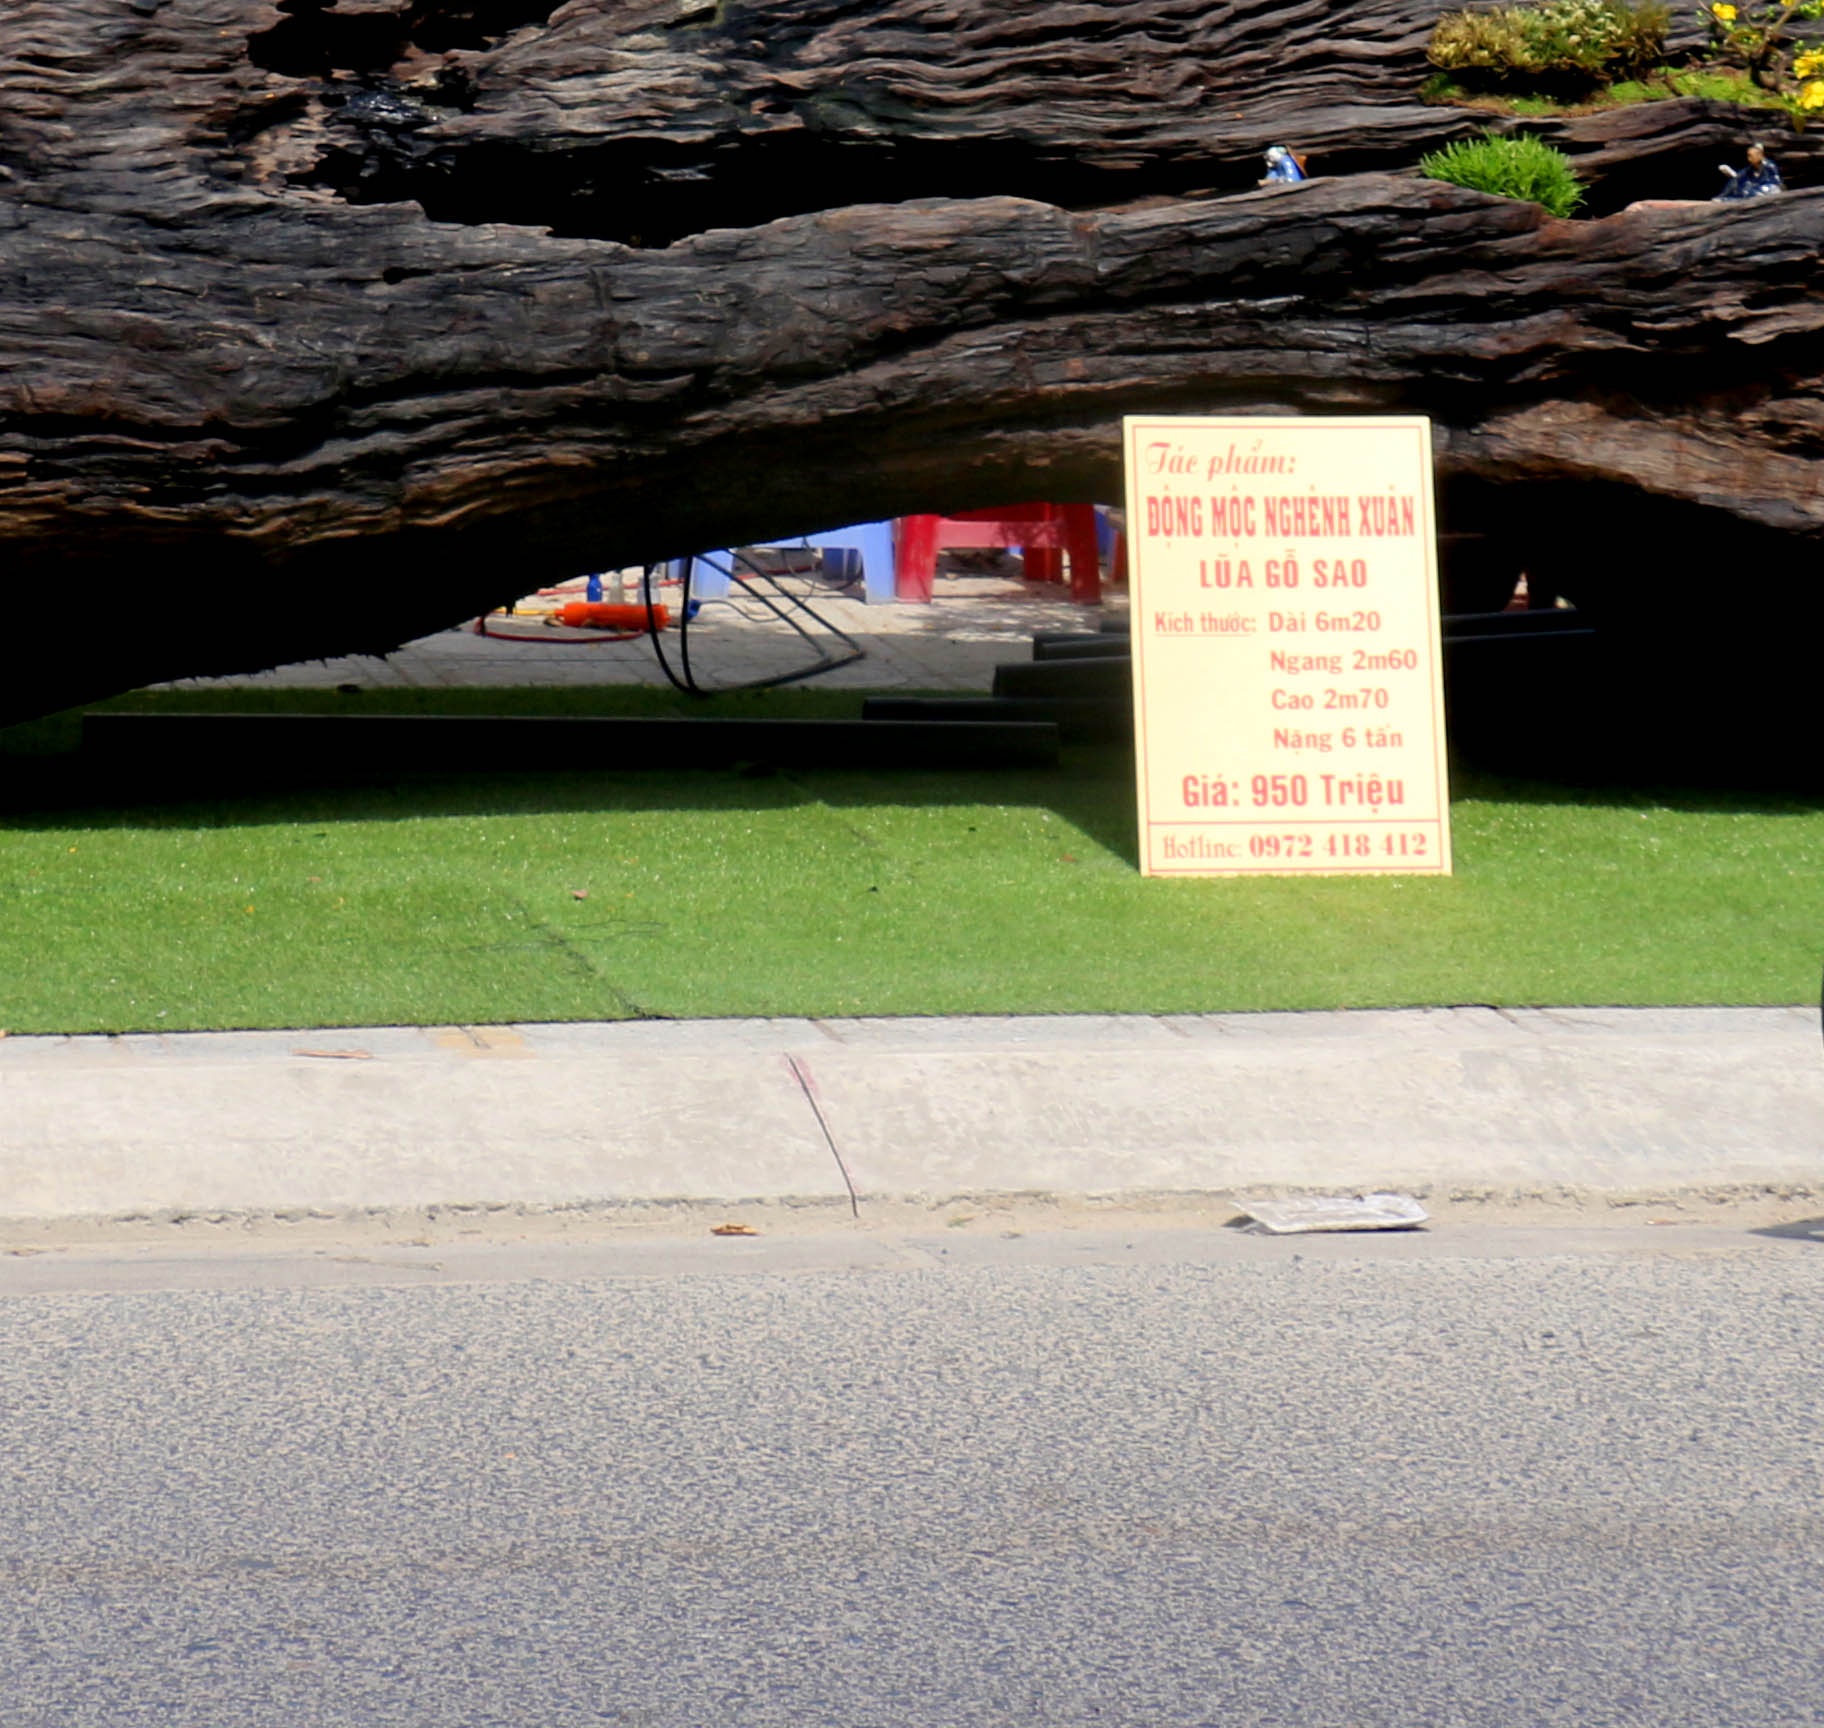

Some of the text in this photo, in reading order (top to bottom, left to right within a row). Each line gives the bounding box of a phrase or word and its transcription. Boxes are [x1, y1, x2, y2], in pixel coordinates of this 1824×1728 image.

[1145, 439, 1297, 482] Tác phẩm:
[1265, 549, 1300, 589] GỖ
[1313, 558, 1368, 589] SAO
[1269, 610, 1307, 633] Dài
[1315, 610, 1382, 632] 6m20
[1269, 649, 1418, 675] Ngang 2m60
[1271, 688, 1390, 710] Cao 2m70
[1342, 727, 1357, 749] 6
[1365, 723, 1404, 749] tấn
[1182, 773, 1405, 815] Giá: 950 Triệu
[1249, 834, 1313, 859] 0972
[1323, 833, 1371, 857] 418
[1379, 832, 1428, 857] 412
